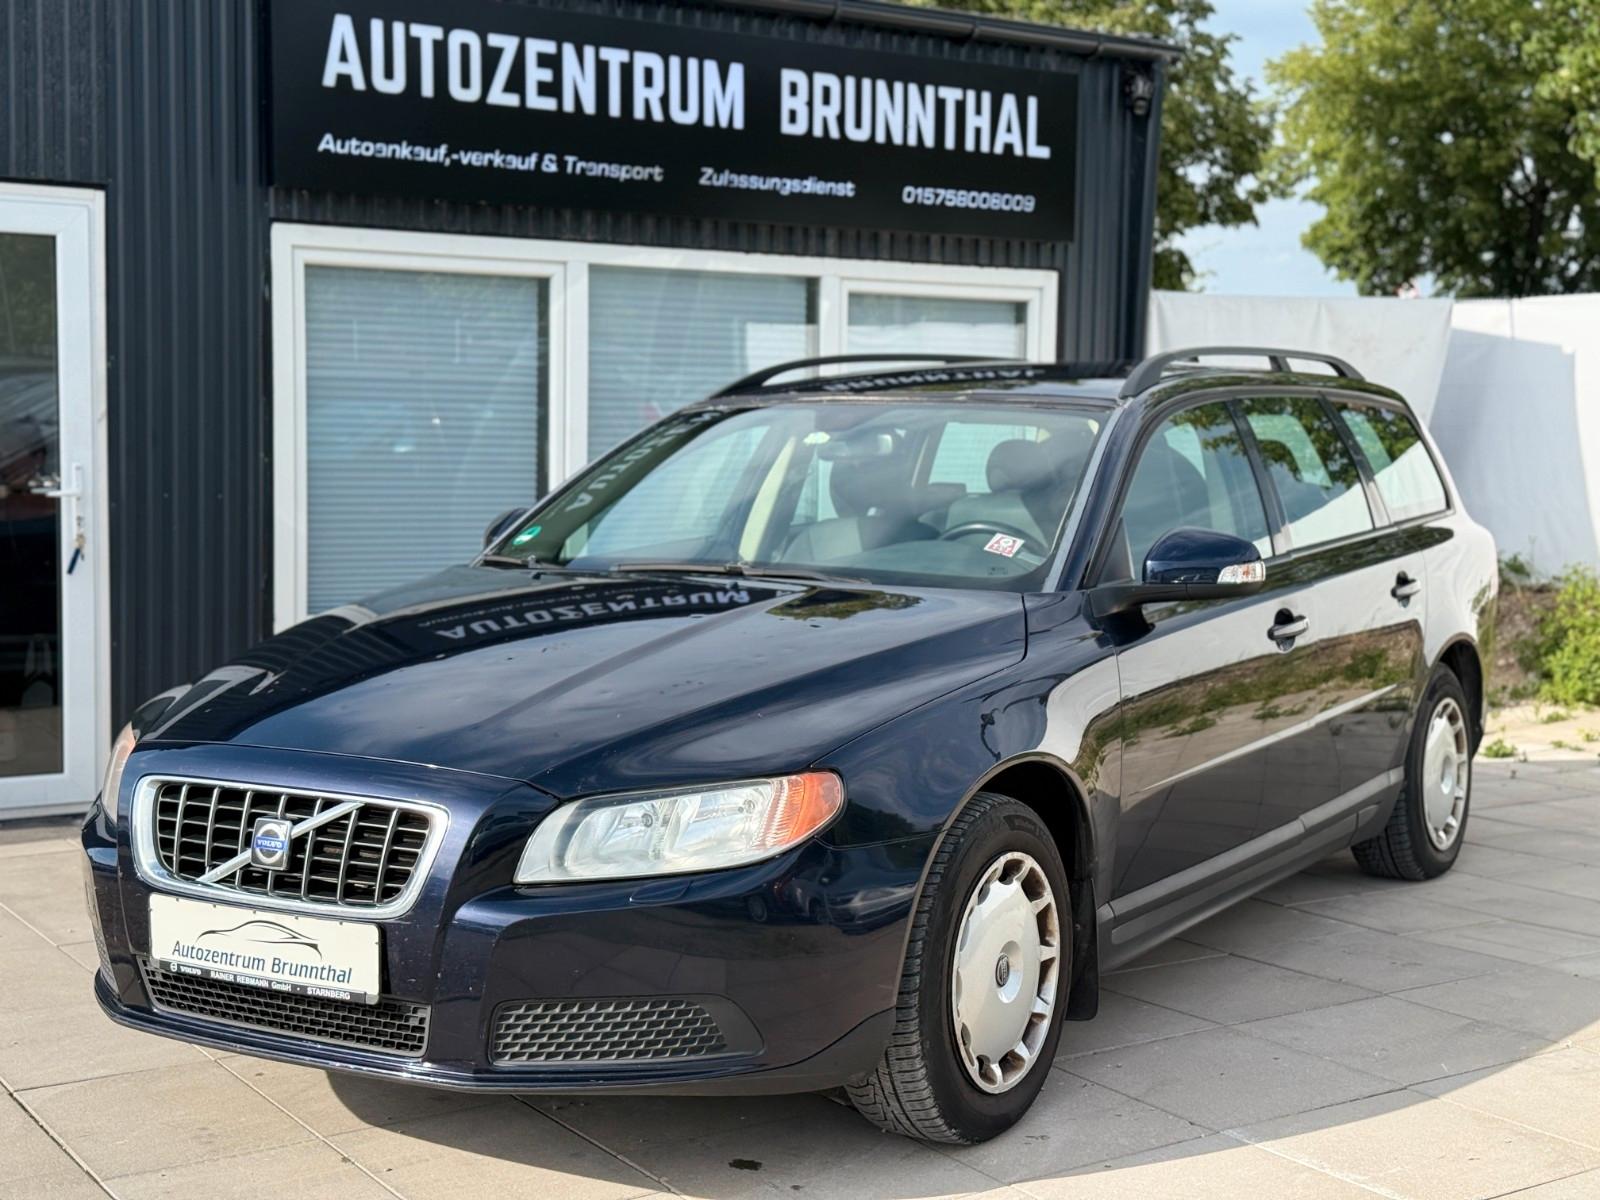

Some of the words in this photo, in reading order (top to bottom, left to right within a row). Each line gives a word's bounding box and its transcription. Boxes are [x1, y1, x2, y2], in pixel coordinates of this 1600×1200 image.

[322, 13, 745, 130] AUTOZENTRUM
[780, 67, 1051, 160] BRUNNTHAL
[541, 153, 559, 173] &
[563, 155, 664, 182] Transport
[698, 166, 856, 198] Zulassungsdienst
[256, 839, 283, 848] VOLVO
[172, 940, 265, 971] Autozentrum
[271, 957, 352, 984] Brunnthal
[271, 981, 292, 992] GmbH
[306, 986, 352, 1000] STARNBERG
